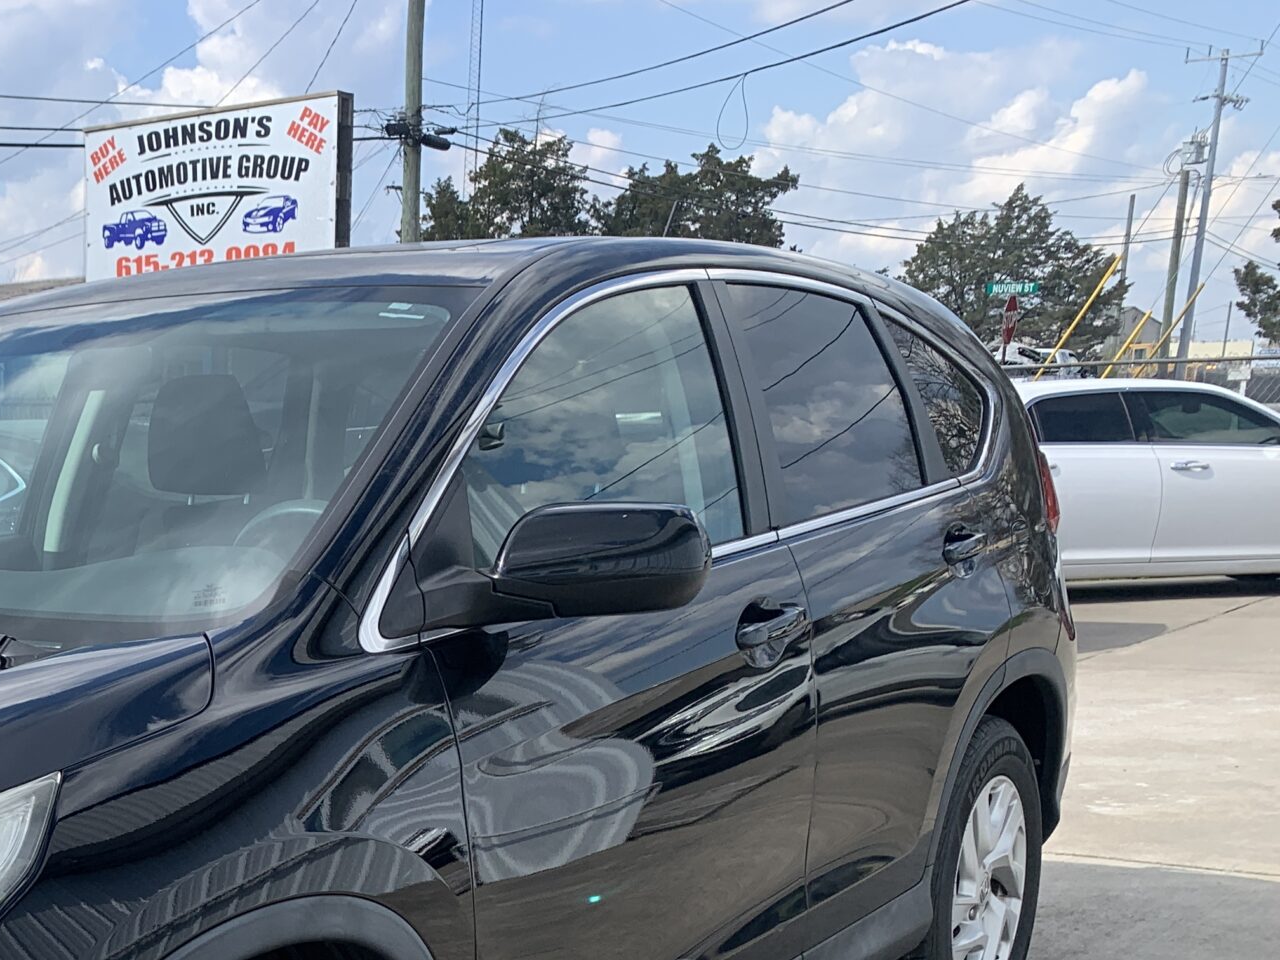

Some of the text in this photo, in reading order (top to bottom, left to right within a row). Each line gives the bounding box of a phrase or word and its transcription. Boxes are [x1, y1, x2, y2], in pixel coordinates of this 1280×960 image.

[137, 115, 273, 156] JOHNSON'S
[299, 106, 330, 132] PAY
[89, 136, 116, 167] BUY
[286, 121, 327, 155] HERE
[93, 148, 127, 184] HERE
[108, 154, 310, 206] AUTOMOTIVE GROUP
[190, 201, 220, 217] INC.
[992, 282, 1035, 293] NUVIEW ST
[968, 738, 1018, 804] IRONMAN
